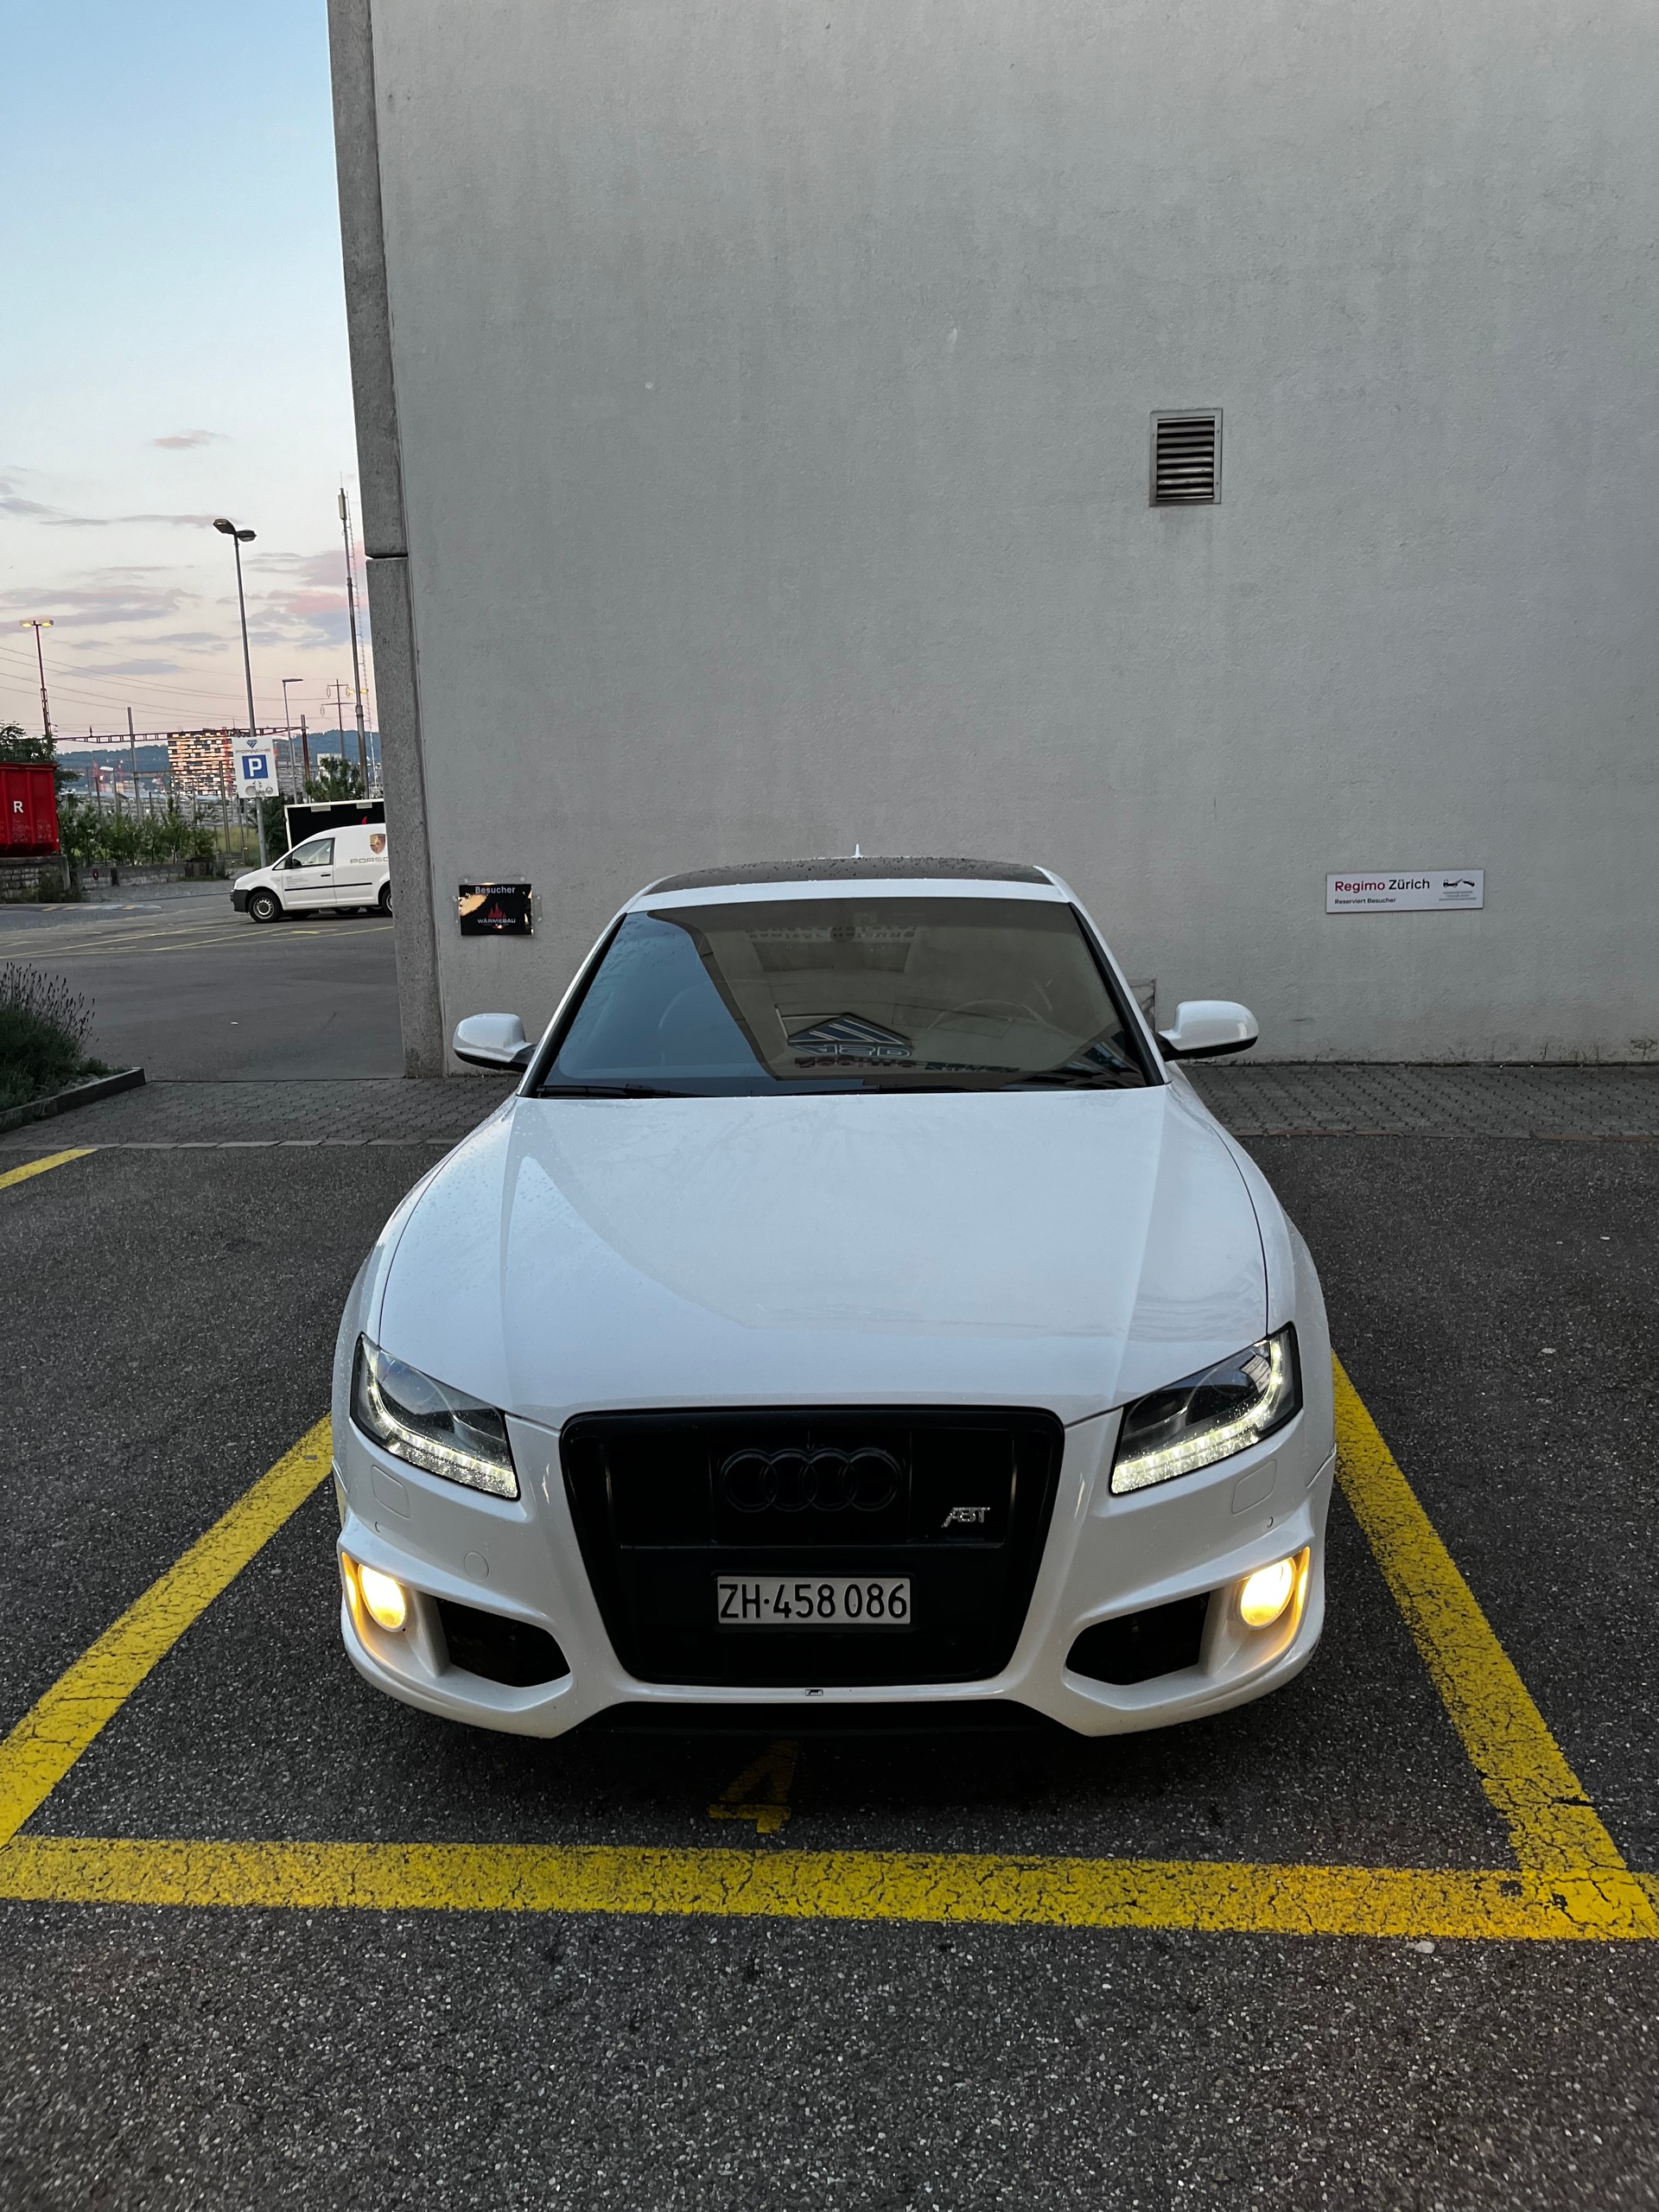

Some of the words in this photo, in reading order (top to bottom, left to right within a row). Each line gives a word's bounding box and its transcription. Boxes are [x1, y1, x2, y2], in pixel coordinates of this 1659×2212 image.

[248, 758, 263, 777] P
[13, 800, 24, 813] R
[474, 886, 516, 894] Besucher
[1334, 880, 1386, 893] Regimo
[1388, 878, 1430, 891] Zürich
[940, 1506, 991, 1529] ABT
[708, 1739, 798, 1834] 4
